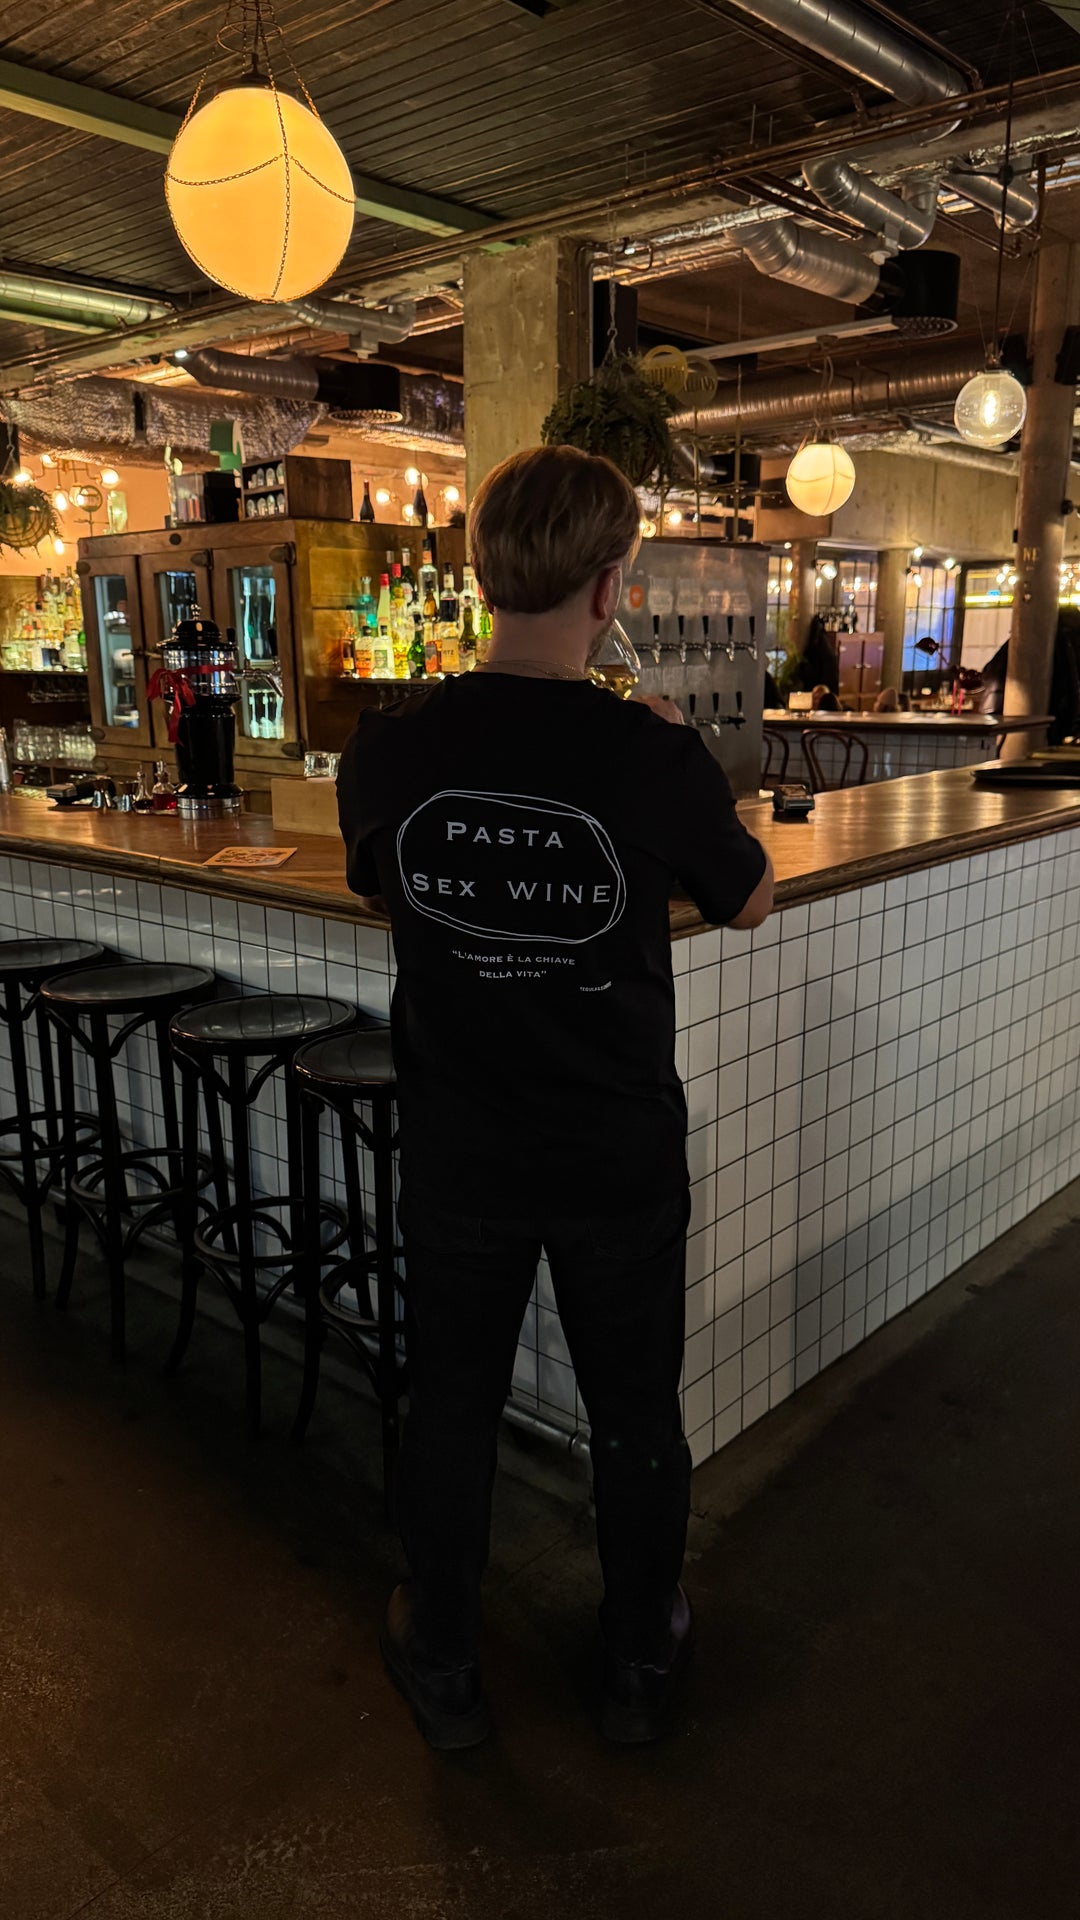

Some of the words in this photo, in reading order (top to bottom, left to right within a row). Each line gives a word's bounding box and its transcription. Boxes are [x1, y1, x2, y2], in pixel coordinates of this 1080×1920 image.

[446, 821, 564, 849] PASTA
[412, 873, 476, 897] SEX
[507, 880, 611, 904] WINE
[535, 956, 576, 966] CHIAVE
[479, 970, 513, 979] DELLA
